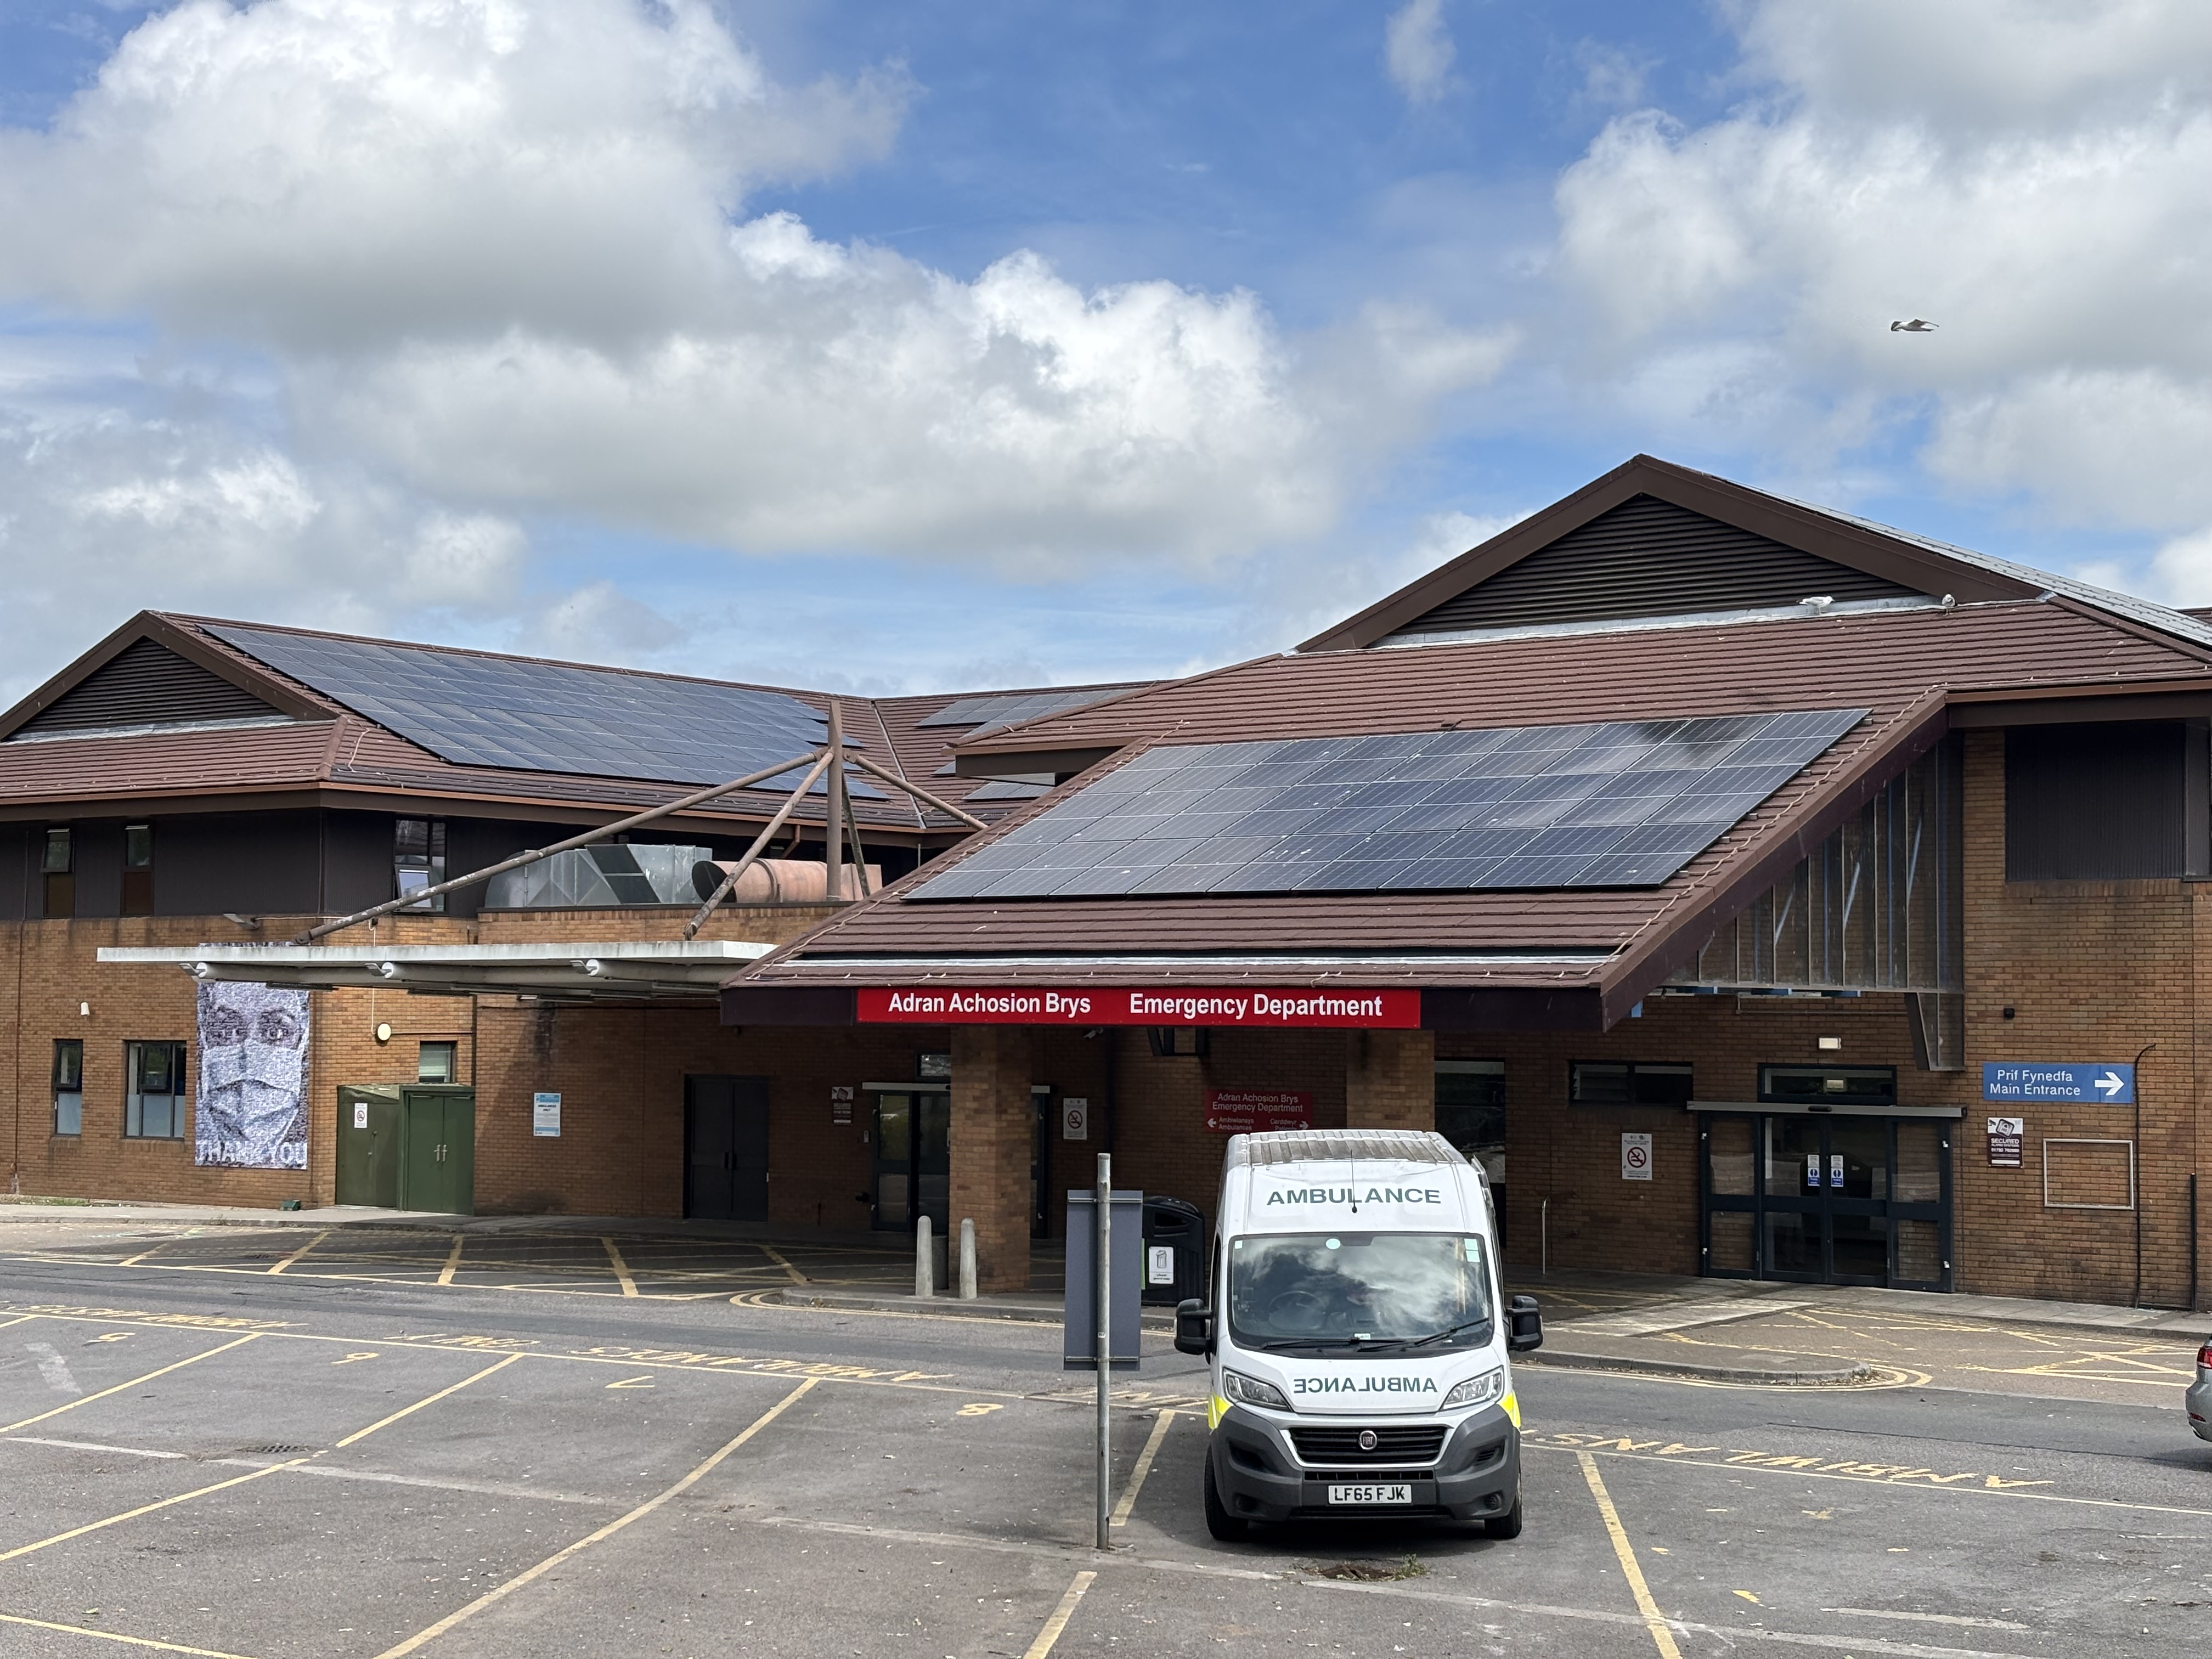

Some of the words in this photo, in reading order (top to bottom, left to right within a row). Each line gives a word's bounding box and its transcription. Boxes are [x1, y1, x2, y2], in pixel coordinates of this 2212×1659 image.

[888, 992, 944, 1012] Adran
[949, 992, 1040, 1013] Achosion
[1046, 992, 1091, 1018] Brys
[1130, 993, 1248, 1020] Emergency
[1254, 994, 1383, 1020] Department
[1997, 1069, 2018, 1081] Prif
[2022, 1070, 2073, 1084] Fynedfa
[1990, 1084, 2019, 1094] Main
[2024, 1084, 2080, 1097] Entrance
[1217, 1093, 1240, 1102] Adran
[1242, 1093, 1278, 1102] Achosion
[1280, 1094, 1299, 1105] Brys
[1212, 1102, 1256, 1113] Emergency
[1257, 1103, 1303, 1113] Department
[1266, 1187, 1441, 1206] AMBULANCE
[87, 1332, 136, 1342] 5
[331, 1352, 379, 1364] 6
[568, 1346, 955, 1381] AMBULANCES
[605, 1375, 654, 1389] 7
[956, 1403, 1003, 1416] 8
[1363, 1436, 1373, 1446] FIAT
[1521, 1430, 2054, 1488] AMBIWLANS
[1334, 1486, 1372, 1502] LF65
[1376, 1486, 1406, 1501] FJK
